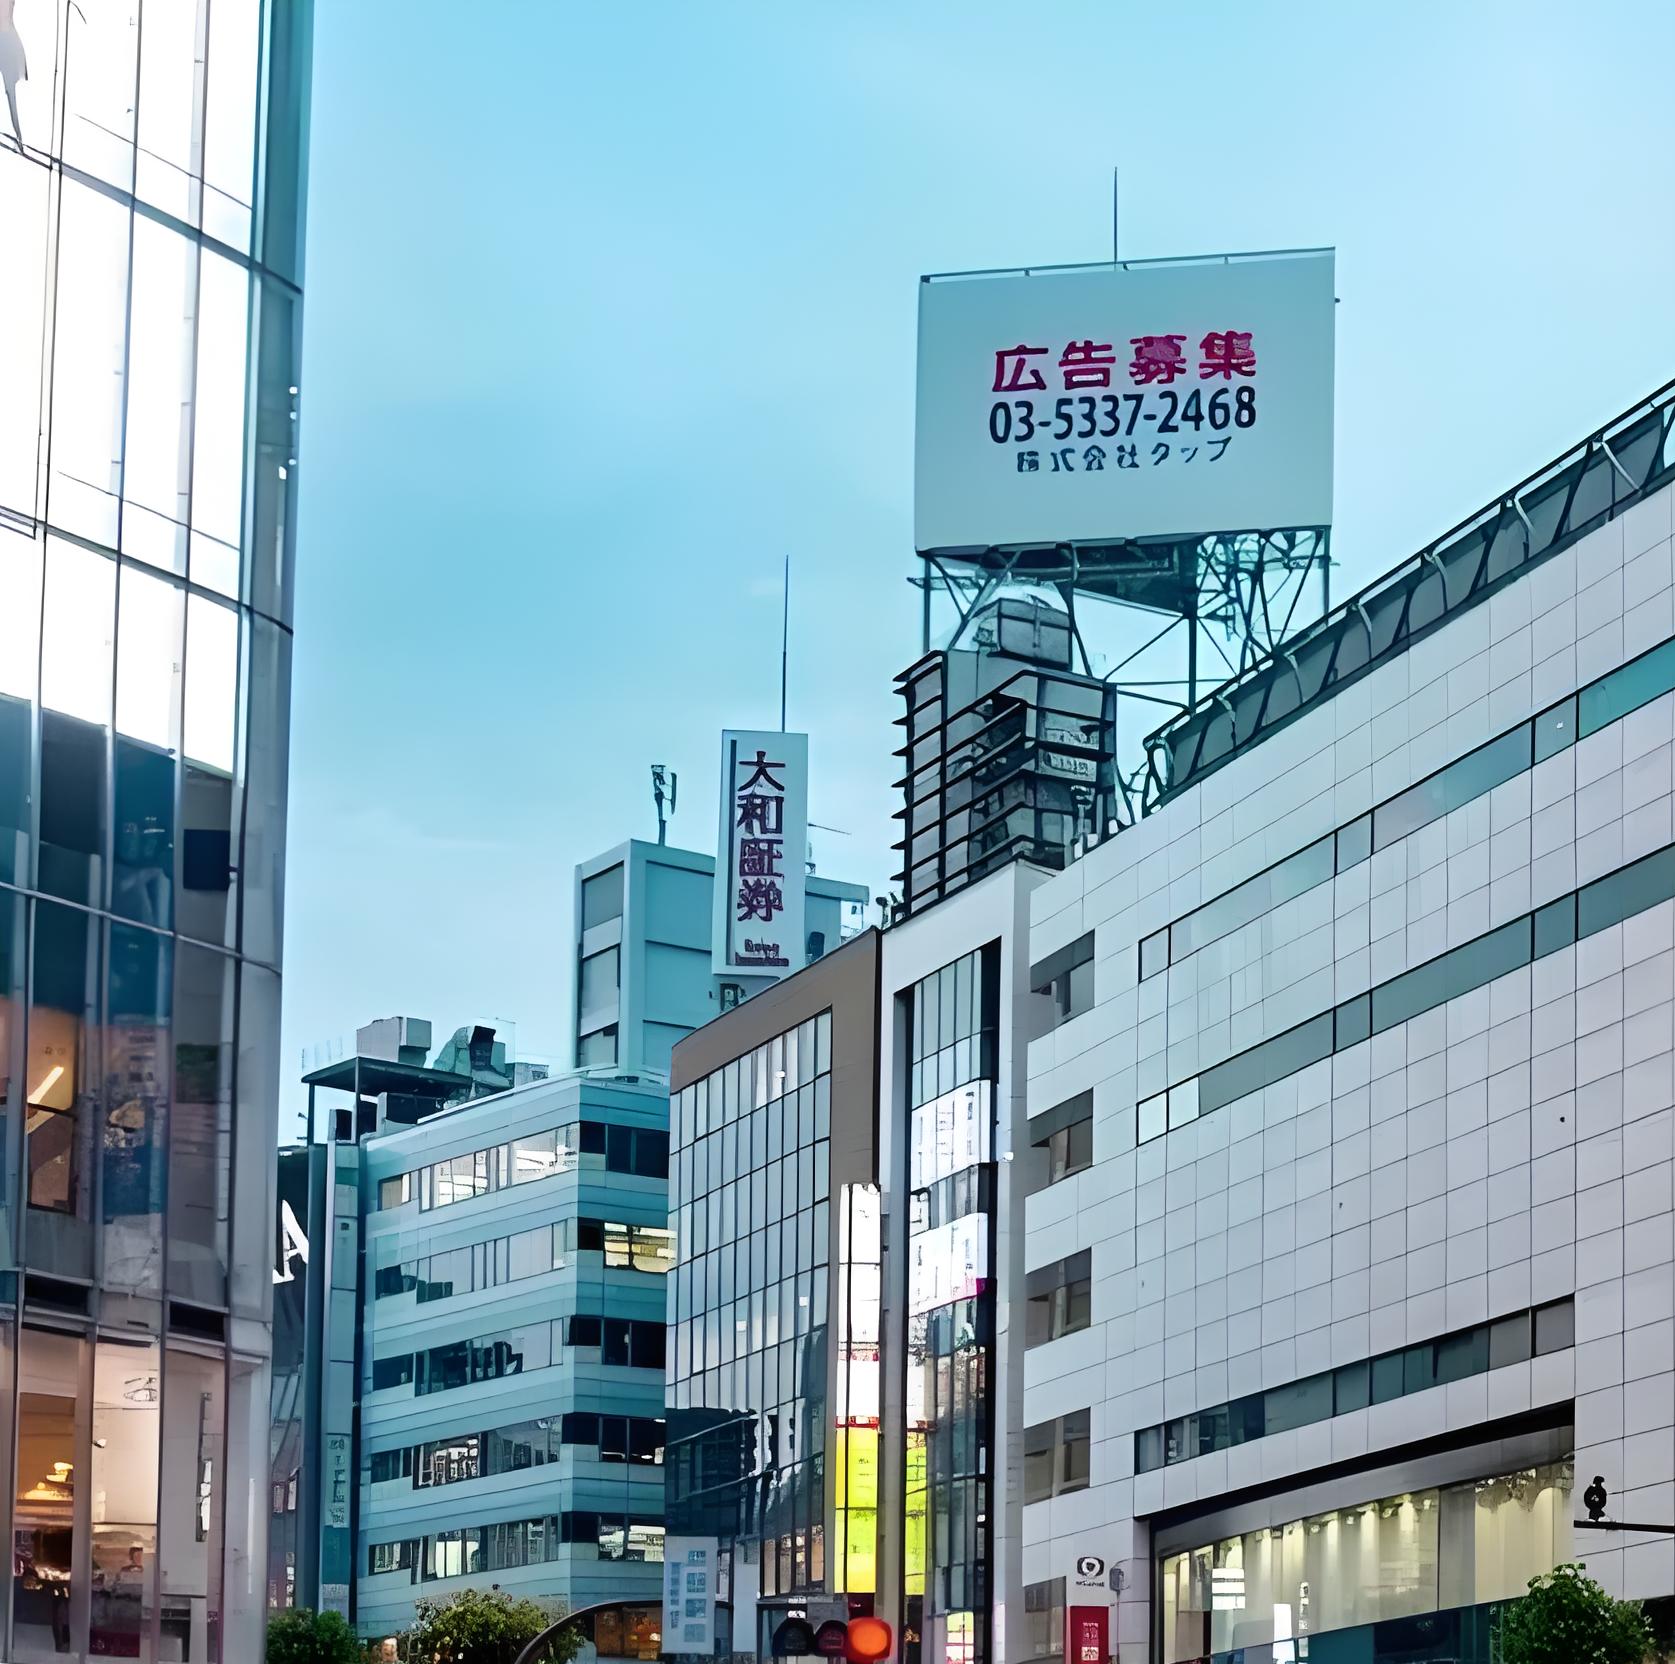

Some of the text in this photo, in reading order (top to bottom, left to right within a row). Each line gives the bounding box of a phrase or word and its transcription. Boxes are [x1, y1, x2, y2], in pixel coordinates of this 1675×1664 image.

[991, 330, 1257, 393] 広告募集
[988, 385, 1257, 445] 03-5337-2468
